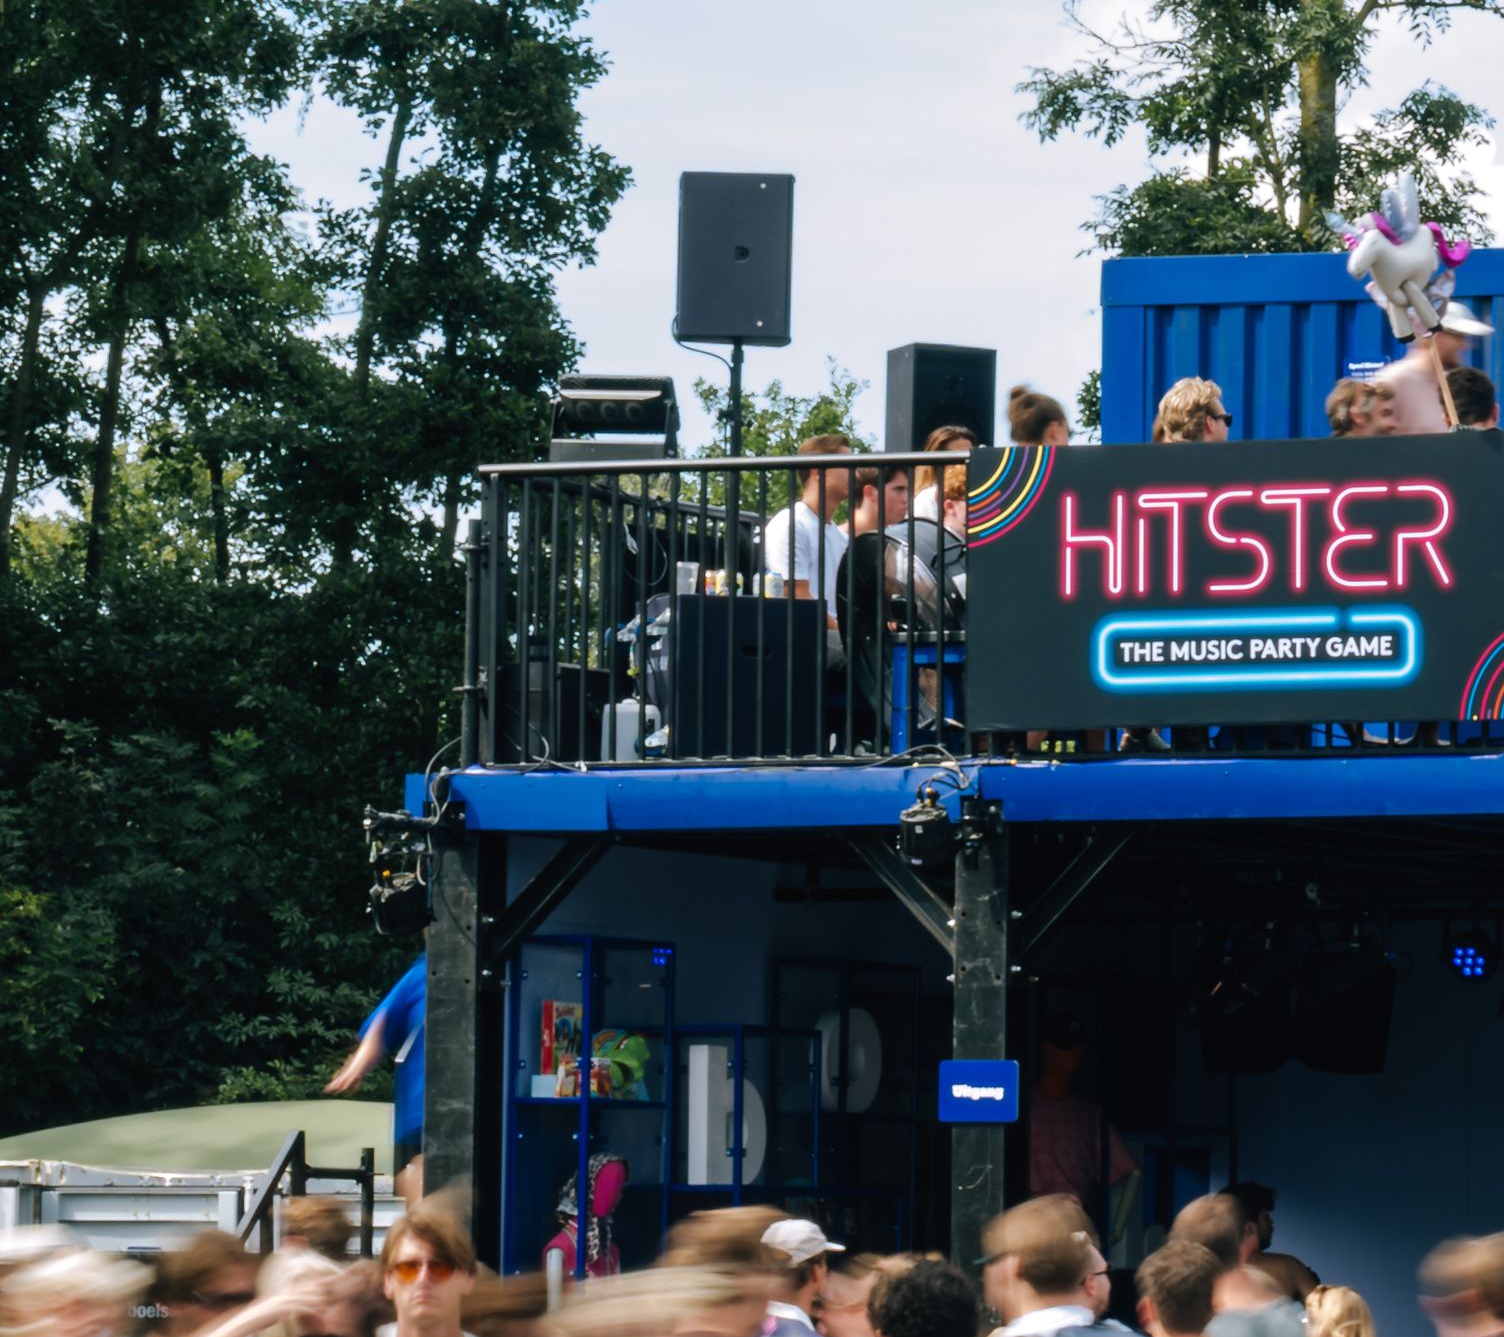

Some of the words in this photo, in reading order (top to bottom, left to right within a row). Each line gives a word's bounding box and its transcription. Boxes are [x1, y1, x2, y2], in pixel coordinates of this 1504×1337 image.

[1059, 481, 1457, 599] HITSTER
[1119, 641, 1165, 663] THE
[1169, 638, 1245, 662] MUSIC
[1249, 636, 1321, 660] PARTY
[1325, 634, 1394, 658] GAME
[951, 1084, 1005, 1101] Uitgang
